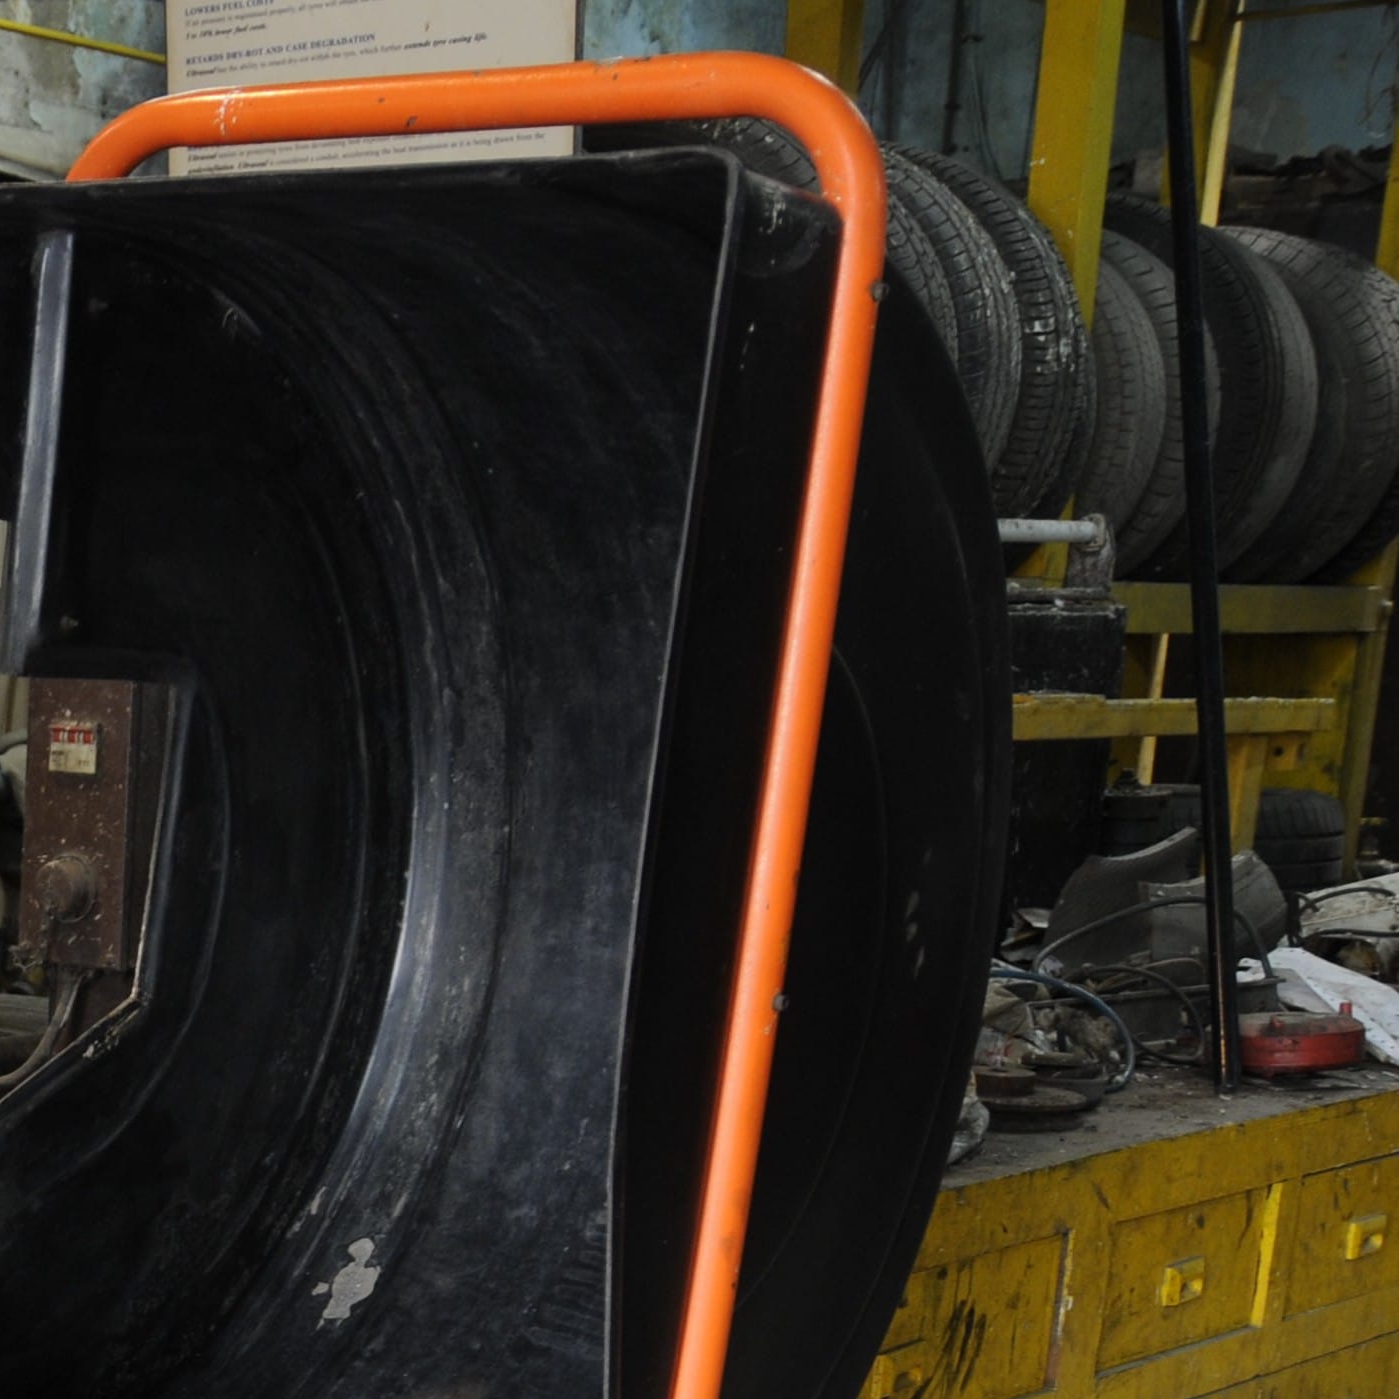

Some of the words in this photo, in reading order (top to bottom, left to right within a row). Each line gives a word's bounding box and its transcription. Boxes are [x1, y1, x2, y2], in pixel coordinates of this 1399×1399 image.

[185, 4, 221, 16] LOWERS
[222, 1, 244, 11] FUEL
[186, 53, 224, 65] RETARDS
[266, 46, 284, 55] AND
[286, 42, 308, 53] CASE
[310, 33, 376, 49] DEGRADATION
